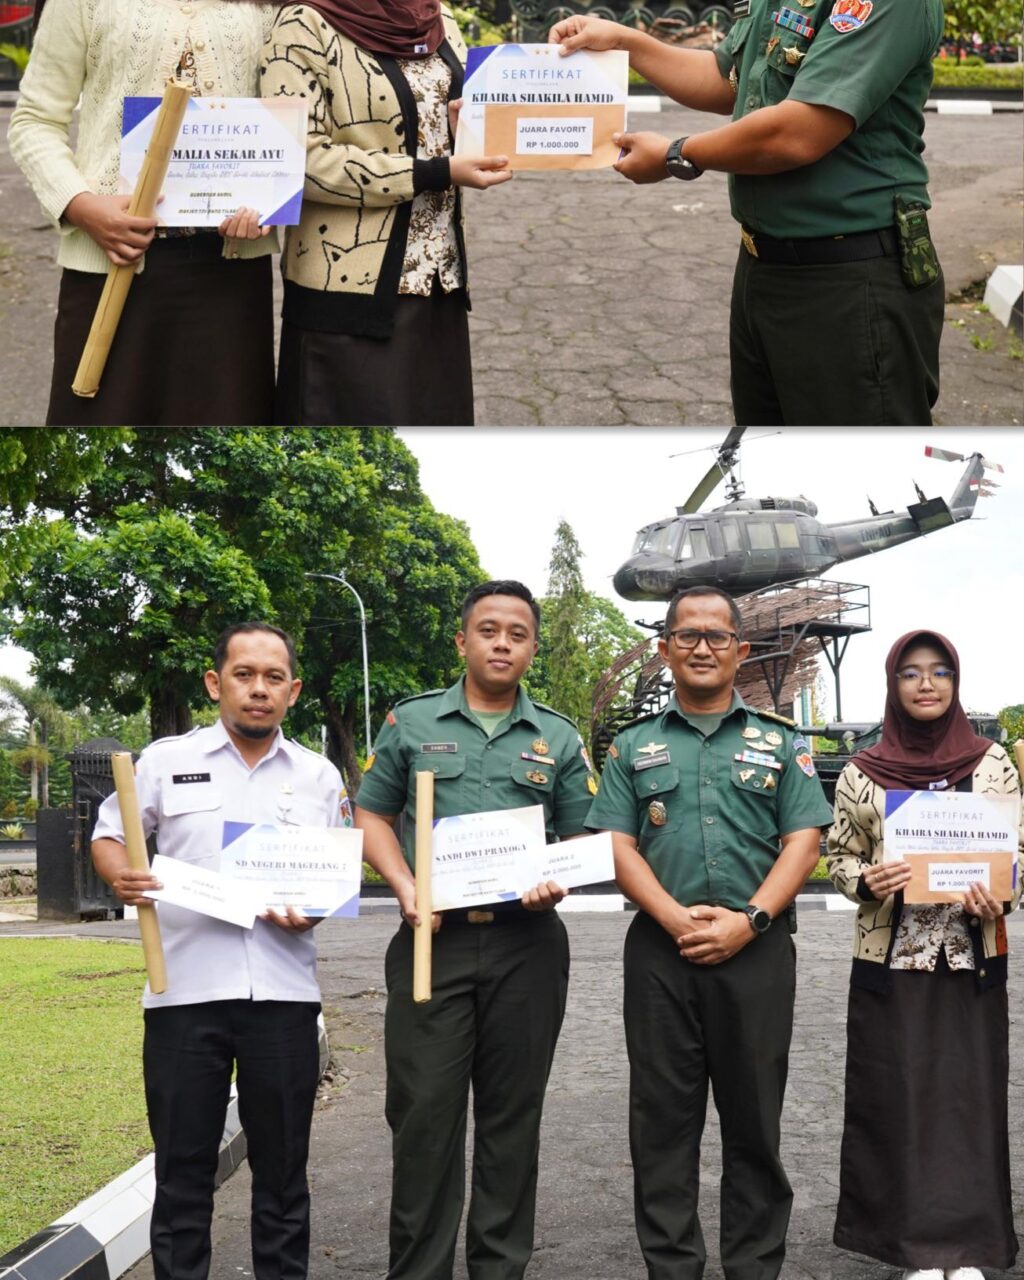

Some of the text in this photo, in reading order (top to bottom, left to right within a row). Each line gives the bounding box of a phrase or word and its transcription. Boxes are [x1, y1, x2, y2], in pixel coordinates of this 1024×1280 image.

[503, 69, 582, 79] SERTIFIKAT
[472, 93, 614, 103] KHAIRA SHAKILA HAMID
[183, 124, 260, 135] ERTIFIKAT
[173, 149, 284, 159] MALIA SEKAR AYU
[920, 812, 984, 820] SERTIFIKAT
[895, 829, 931, 837] KHAIRA
[934, 830, 974, 838] SHAKILA
[435, 844, 527, 862] SANDI DWI PRAYOGA
[250, 860, 286, 869] NEGERI
[289, 862, 339, 870] MAGELANG
